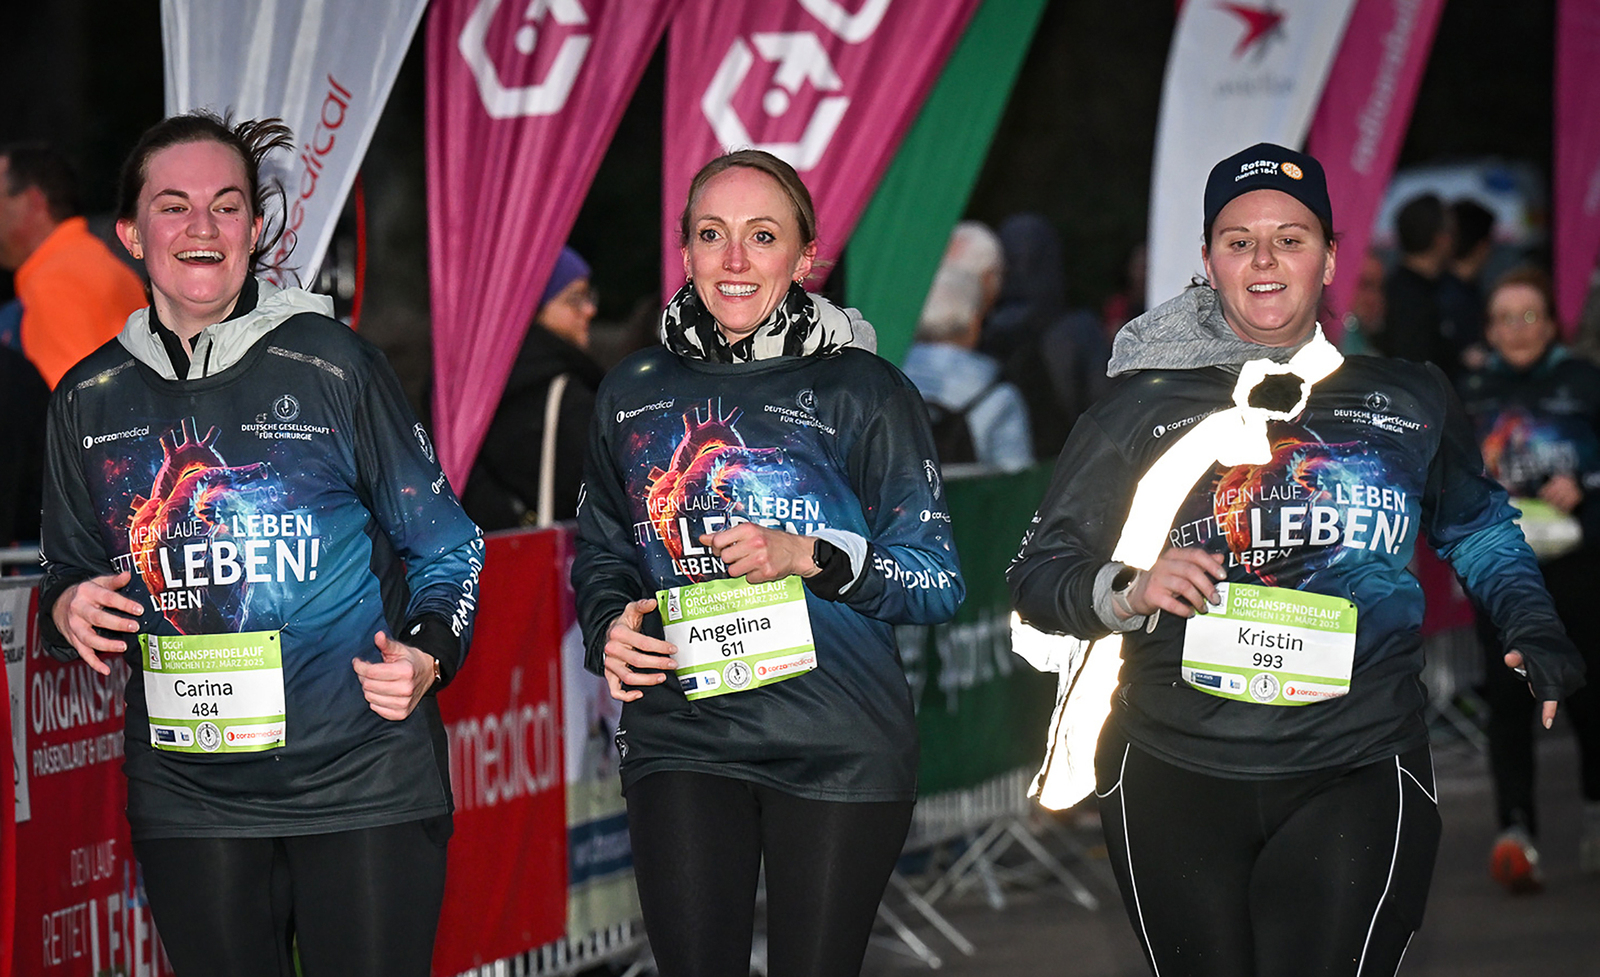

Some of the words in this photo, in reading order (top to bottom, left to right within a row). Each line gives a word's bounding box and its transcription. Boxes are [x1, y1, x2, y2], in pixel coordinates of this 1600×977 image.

[1240, 160, 1279, 173] Rotary
[266, 72, 353, 289] medical
[764, 405, 799, 417] DEUTSCHE
[1333, 409, 1371, 419] DEUTSCHE
[241, 423, 278, 432] DEUTSCHE
[278, 423, 330, 435] GESELLSCHAFT
[259, 431, 274, 440] FÜR
[274, 432, 313, 441] CHIRURGIE
[646, 497, 681, 514] MEIN
[685, 495, 720, 511] LAUF
[1213, 486, 1254, 508] MEIN
[1260, 485, 1302, 501] LAUF
[1335, 483, 1407, 513] LEBEN
[748, 495, 820, 521] LEBEN
[128, 526, 162, 544] MEIN
[166, 520, 203, 540] LAUF
[232, 514, 313, 538] LEBEN
[1169, 510, 1244, 549] RETTET
[1251, 506, 1410, 555] LEBEN!
[159, 537, 321, 588] LEBEN!
[671, 557, 727, 577] LEBEN
[1228, 547, 1293, 568] LEBEN
[150, 589, 202, 612] LEBEN
[684, 587, 706, 597] DGCH
[685, 581, 787, 608] ORGANSPENDELAUF
[1234, 587, 1260, 597] DGCH
[686, 604, 726, 617] MÜNCHEN
[745, 594, 767, 607] MÄRZ
[769, 592, 789, 602] 2025
[1233, 597, 1342, 620] ORGANSPENDELAUF
[1232, 607, 1274, 620] MÜNCHEN
[1295, 615, 1317, 626] MÄRZ
[1318, 619, 1341, 629] 2025
[688, 616, 772, 644] Angelina
[1237, 626, 1304, 651] Kristin
[162, 641, 184, 649] DGCH
[163, 646, 264, 661] ORGANSPENDELAUF
[721, 640, 745, 657] 611
[164, 660, 201, 669] MÜNCHEN
[219, 658, 242, 668] MÄRZ
[244, 658, 265, 666] 2025
[767, 657, 814, 673] corzamedical
[1252, 652, 1284, 669] 993
[174, 679, 233, 698] Carina
[191, 702, 219, 716] 484
[235, 728, 283, 740] corzamedical
[448, 656, 562, 811] medical
[43, 902, 88, 968] RETTET
